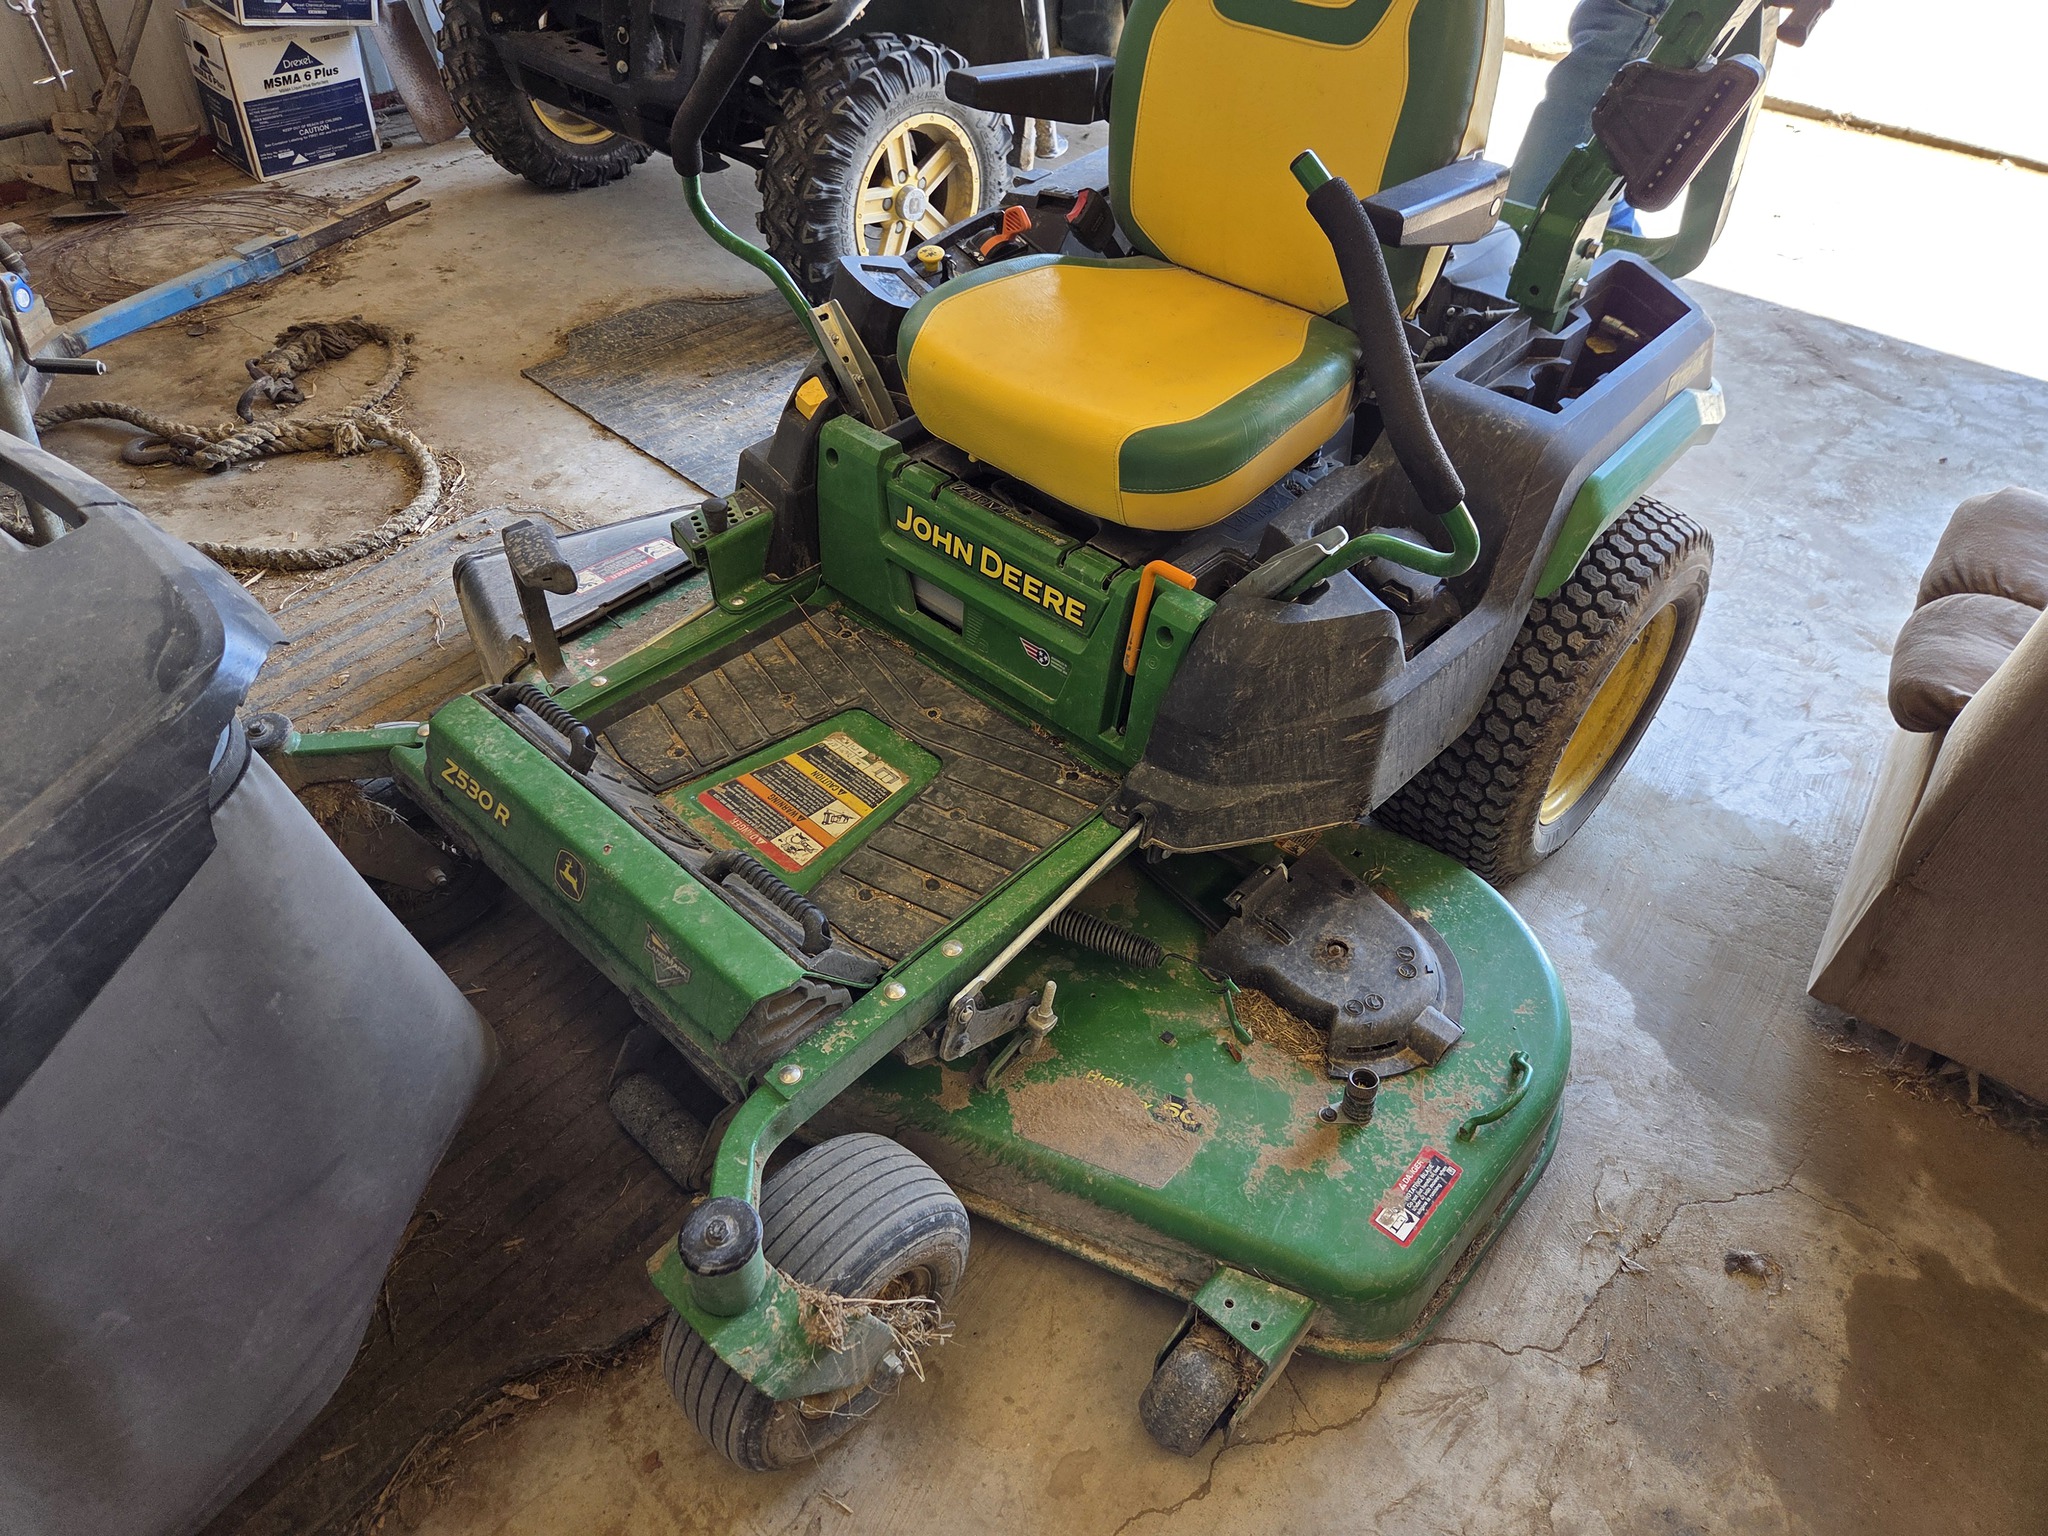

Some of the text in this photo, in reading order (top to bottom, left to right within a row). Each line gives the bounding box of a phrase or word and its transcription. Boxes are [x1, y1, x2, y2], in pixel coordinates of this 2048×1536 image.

[282, 54, 312, 69] Drexel
[263, 66, 339, 90] MSMA 6 Plus
[299, 124, 330, 136] CAUTION
[612, 562, 644, 580] DANGER
[896, 506, 1086, 627] JOHN DEERE
[810, 770, 840, 792] CAUTION
[767, 793, 799, 818] WARNING
[730, 817, 760, 841] DANGER
[646, 941, 688, 978] LANDMARK
[1420, 1163, 1433, 1178] BLADE
[1421, 1176, 1431, 1188] hands
[1411, 1199, 1421, 1211] under
[1429, 1175, 1439, 1187] mower
[1438, 1165, 1447, 1175] when
[1416, 1201, 1428, 1215] engine
[1429, 1183, 1442, 1198] running
